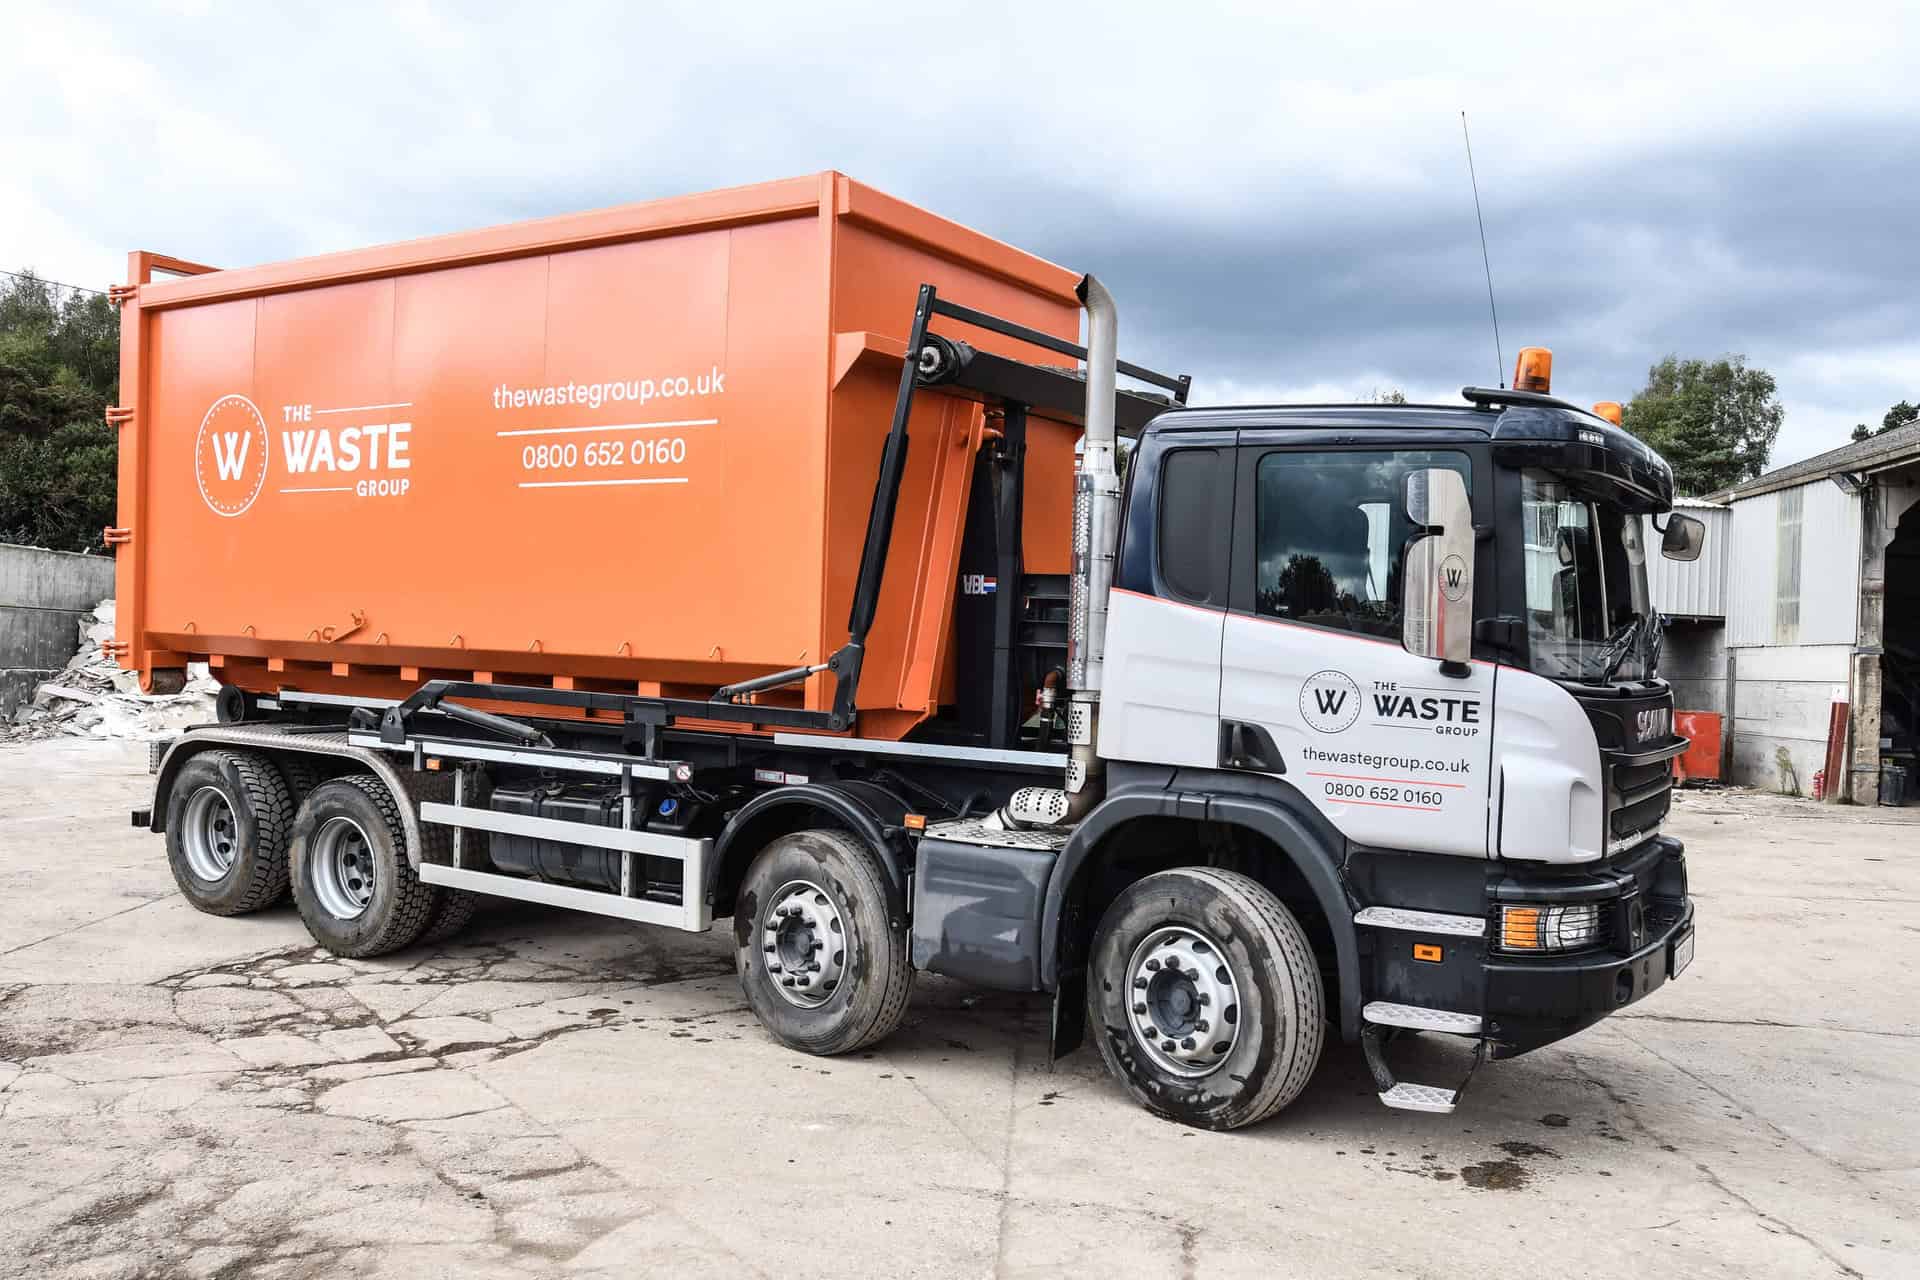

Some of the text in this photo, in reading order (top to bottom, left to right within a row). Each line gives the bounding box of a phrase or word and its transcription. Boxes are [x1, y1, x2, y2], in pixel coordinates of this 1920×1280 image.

[493, 368, 726, 409] thewastegroup.co.uk
[282, 403, 313, 423] THE
[212, 430, 251, 481] W
[281, 422, 412, 473] WASTE
[522, 437, 686, 469] 0800 652 0160
[355, 478, 410, 497] GROUP
[1446, 567, 1462, 589] W
[1373, 681, 1397, 691] THE
[1314, 688, 1347, 716] W
[1373, 693, 1481, 724] WASTE
[1435, 725, 1479, 737] GROUP
[1303, 746, 1470, 773] thewastegroup.co.uk
[1324, 782, 1443, 806] 0800 652 0160
